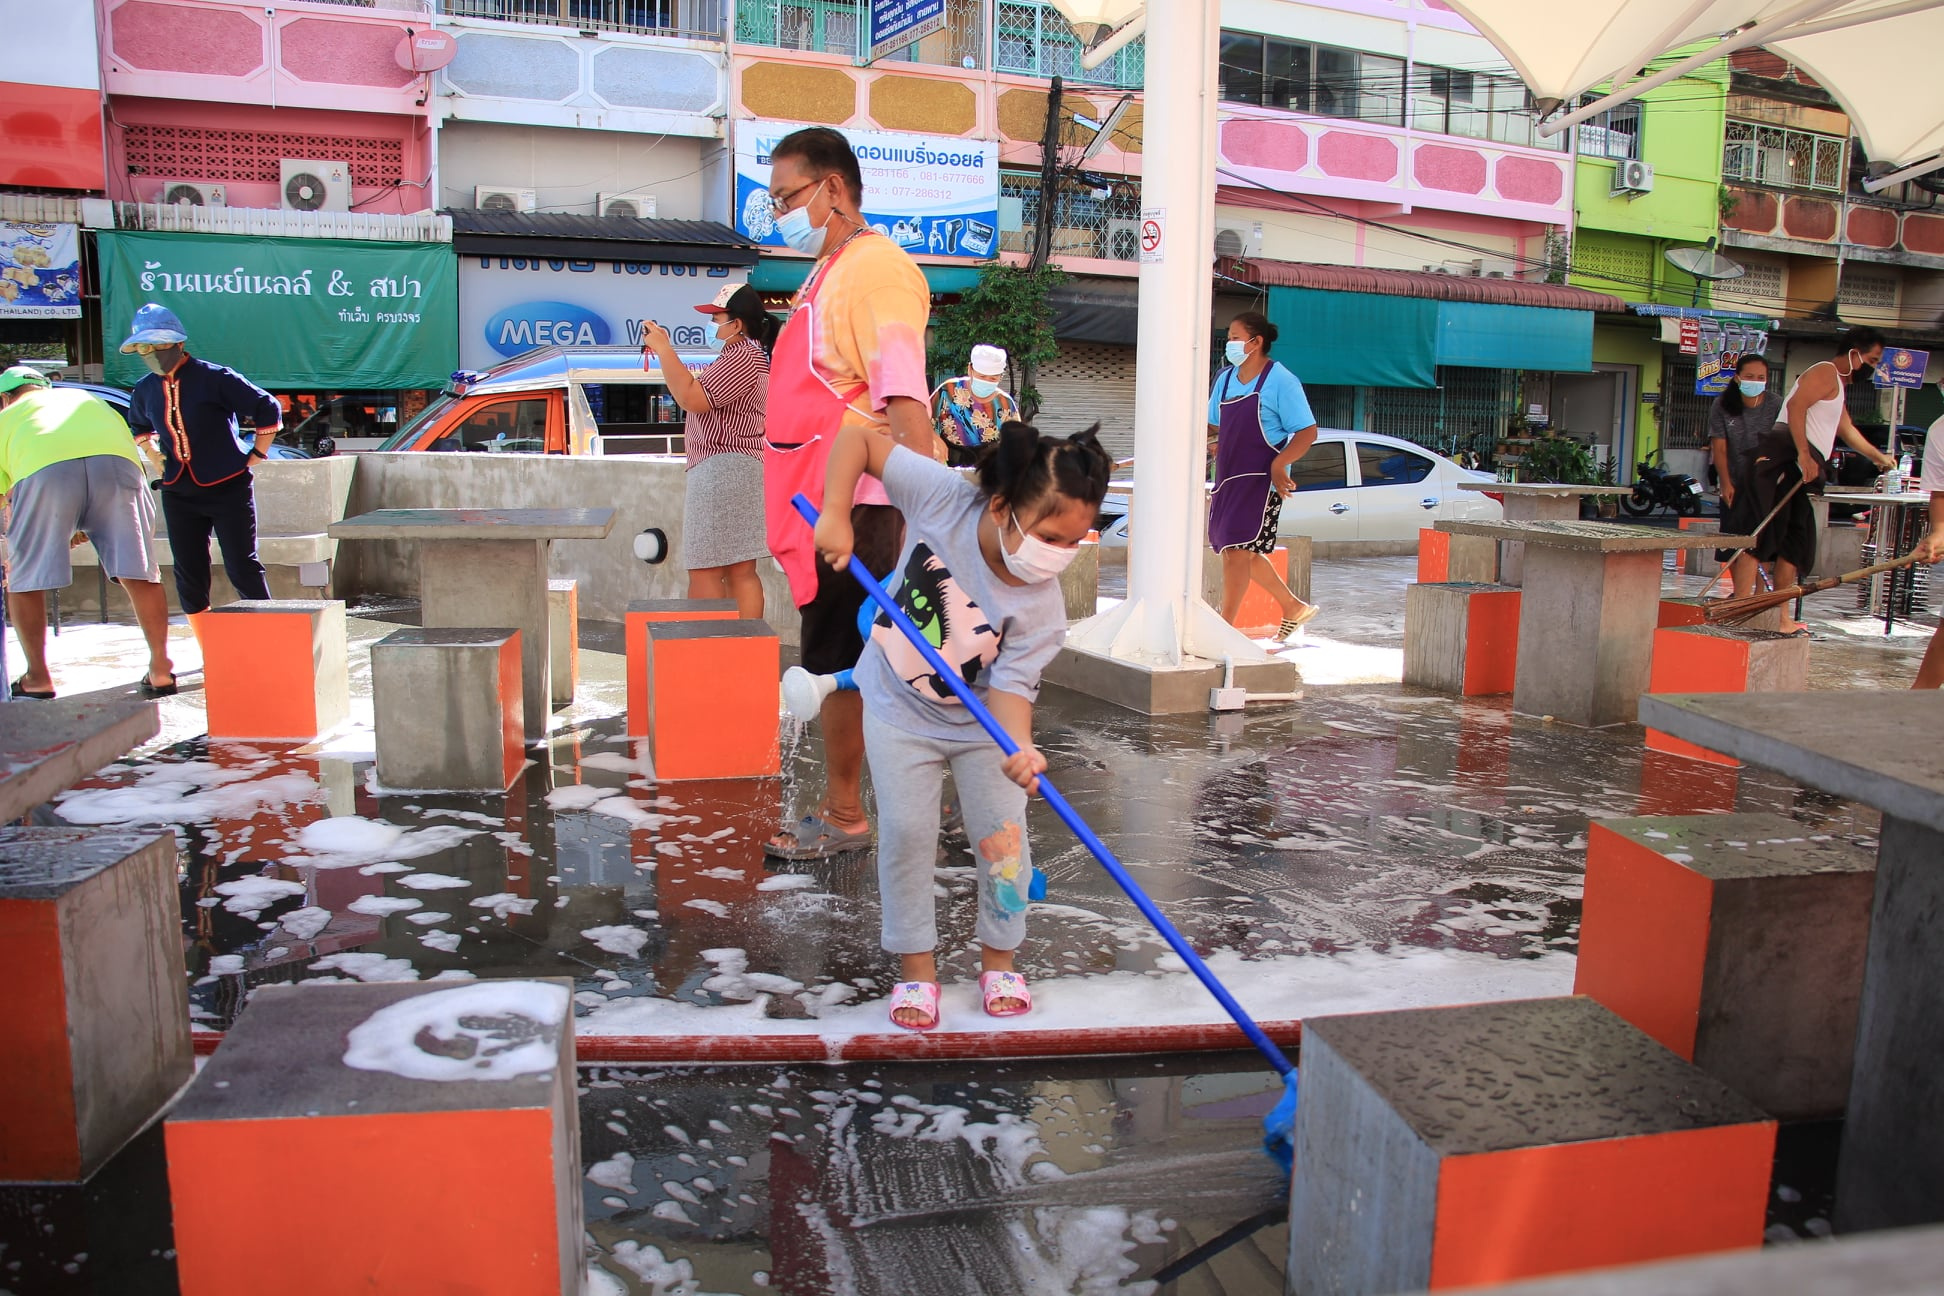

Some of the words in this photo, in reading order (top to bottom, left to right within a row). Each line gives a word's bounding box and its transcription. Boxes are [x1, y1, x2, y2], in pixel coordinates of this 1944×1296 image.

[920, 170, 985, 185] 081-6777666
[891, 186, 952, 200] 077-286312
[140, 260, 313, 296] ร้านเนย์เนลล์
[327, 269, 354, 297] &
[369, 274, 422, 298] สปา
[338, 306, 370, 323] ทำเล็บ
[376, 312, 421, 323] ครบวงจร
[500, 319, 598, 346] MEGA
[1697, 359, 1721, 380] บริการ
